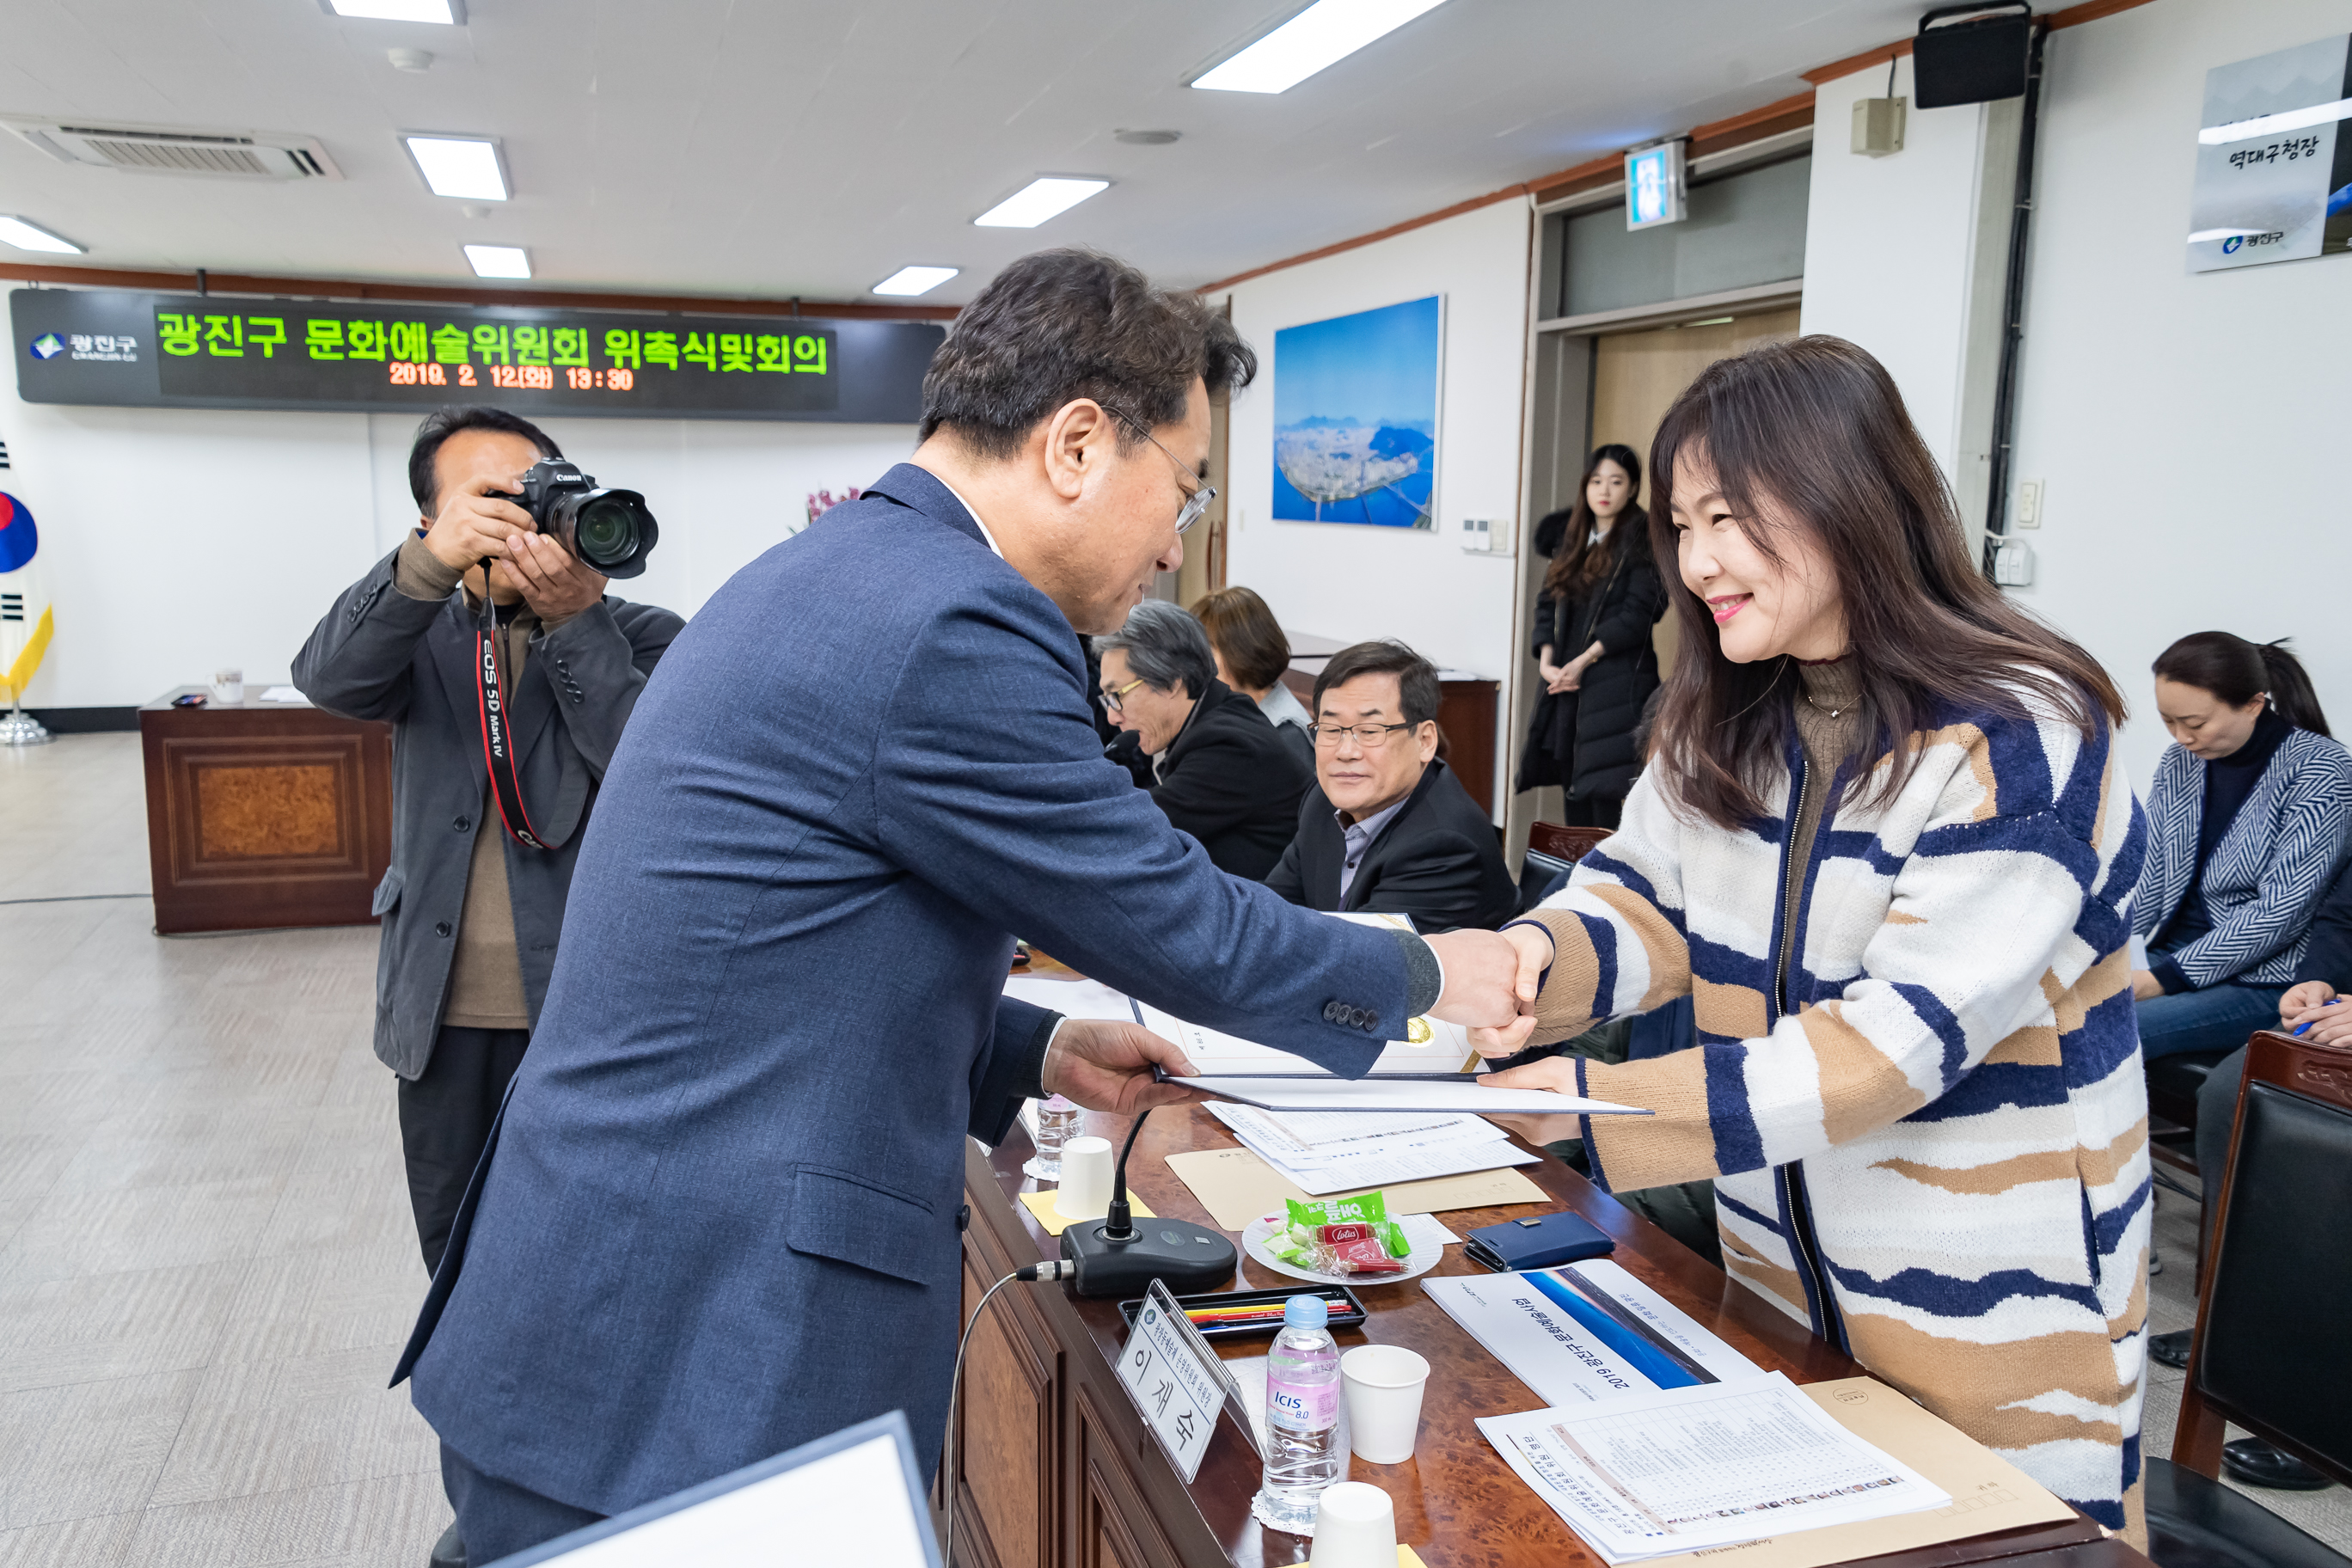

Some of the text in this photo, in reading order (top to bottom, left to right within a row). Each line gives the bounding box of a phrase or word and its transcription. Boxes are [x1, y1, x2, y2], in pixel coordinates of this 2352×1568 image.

[2229, 135, 2319, 169] 역대구청장
[2246, 231, 2283, 247] 광진구
[70, 334, 138, 352] 광진구
[158, 314, 827, 375] 광진구 문화예술위원회 위촉식및회의
[389, 362, 446, 385] 2019.
[458, 364, 477, 386] 2.
[490, 365, 553, 389] 12(화)
[556, 474, 582, 482] Canon
[483, 640, 503, 757] EOS 5D Mark IV
[1336, 1229, 1357, 1240] Lotus
[1511, 1297, 1630, 1389] 2019 광진구 문화예술사업
[1176, 1353, 1198, 1389] 운영위원회
[1197, 1381, 1212, 1407] 위원장
[1275, 1391, 1302, 1409] ICIS
[1295, 1410, 1308, 1419] 8.0
